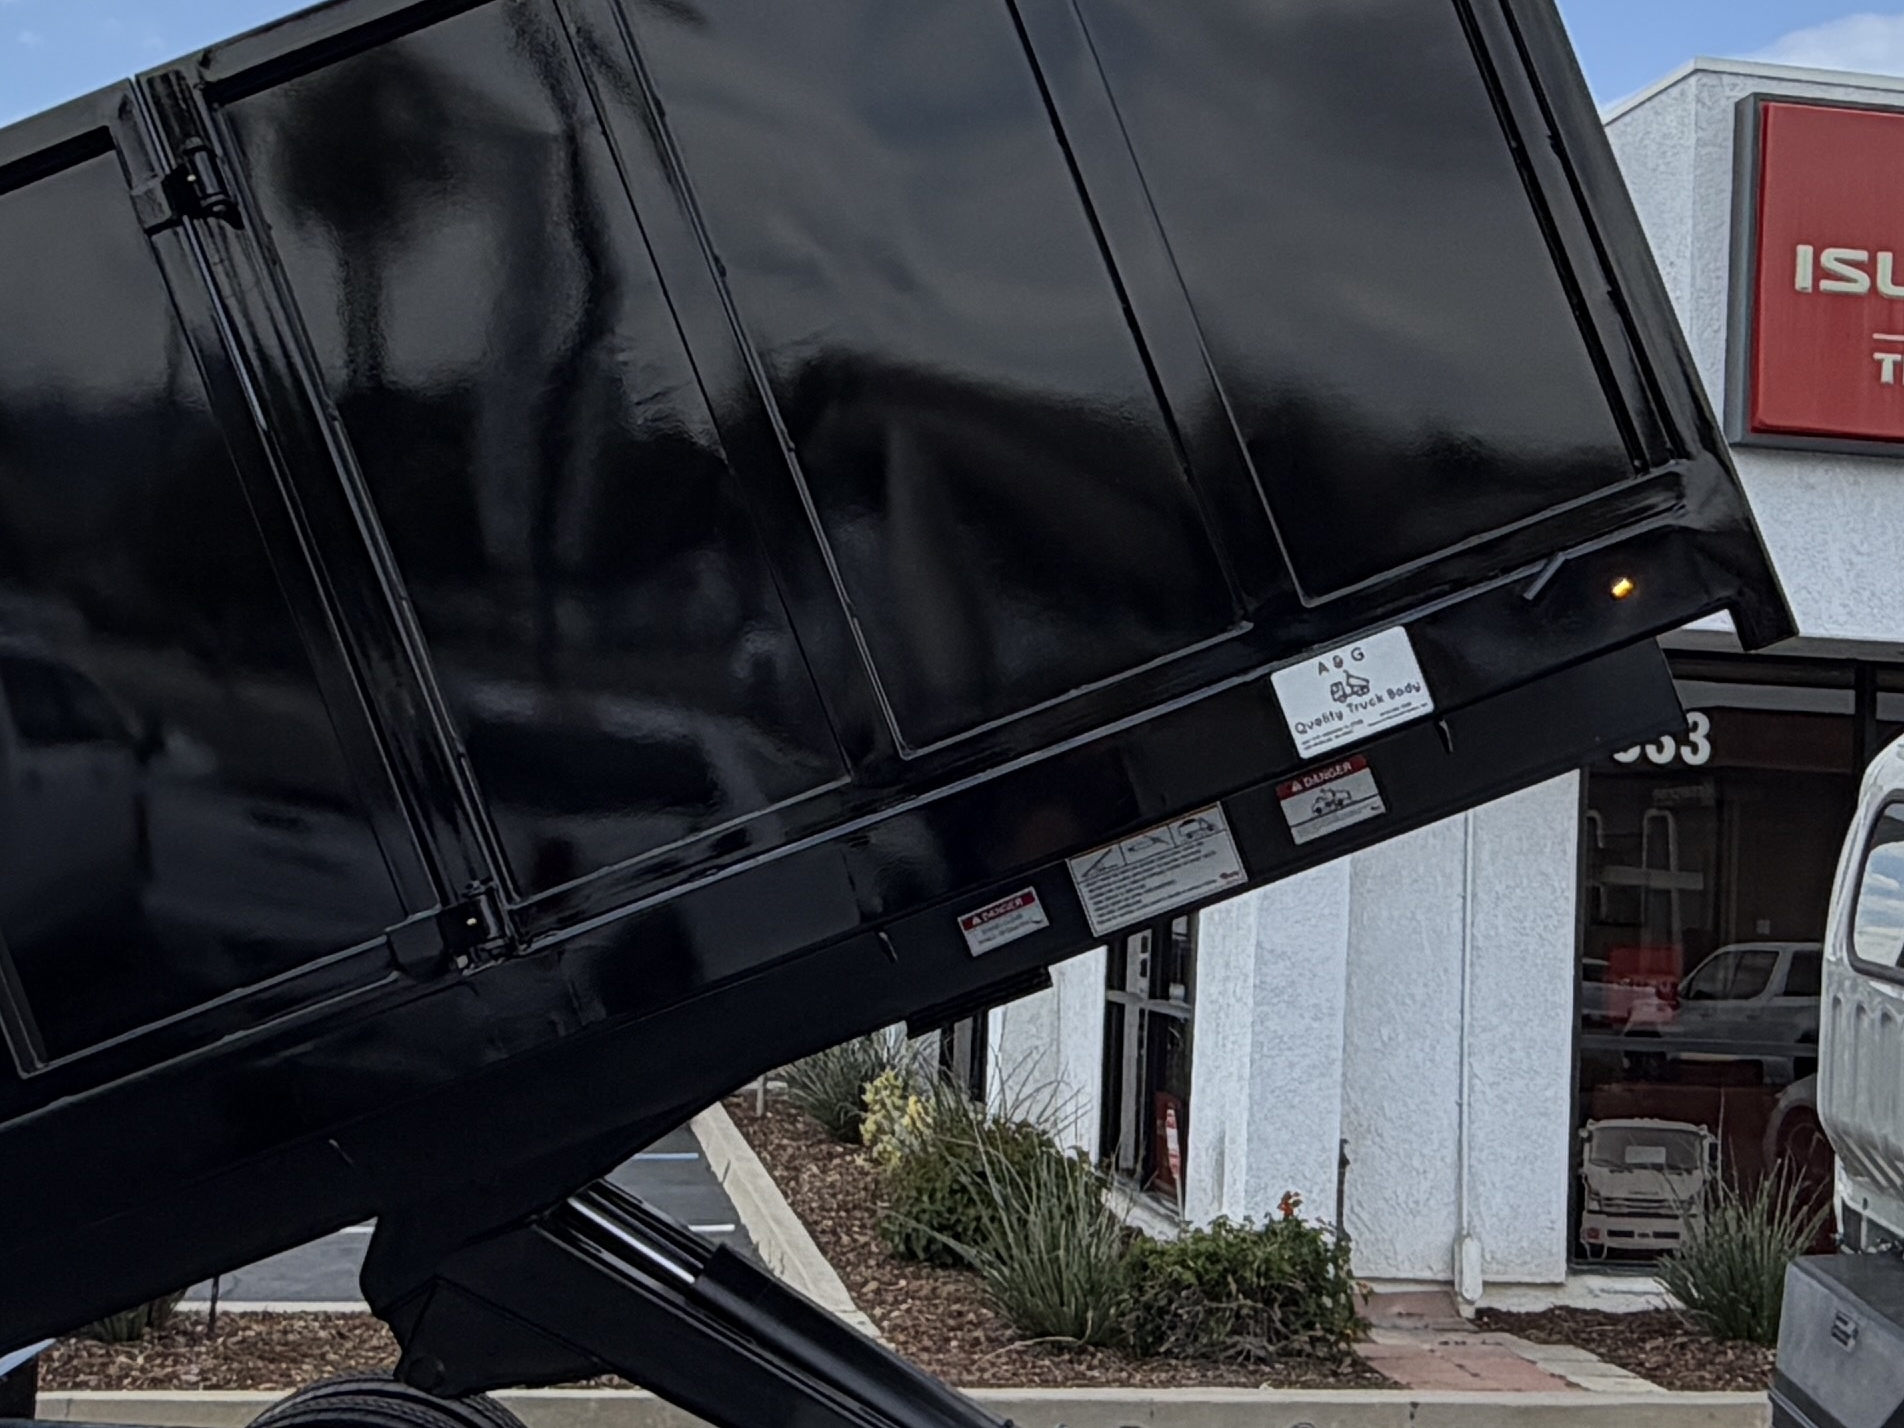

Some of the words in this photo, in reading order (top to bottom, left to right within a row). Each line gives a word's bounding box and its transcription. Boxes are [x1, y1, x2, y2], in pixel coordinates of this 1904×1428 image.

[1318, 660, 1330, 676] A
[1350, 646, 1365, 661] G
[1294, 709, 1343, 735] Quality
[1347, 693, 1384, 714] Truck
[1386, 681, 1421, 700] Body
[1303, 761, 1352, 788] DANGER
